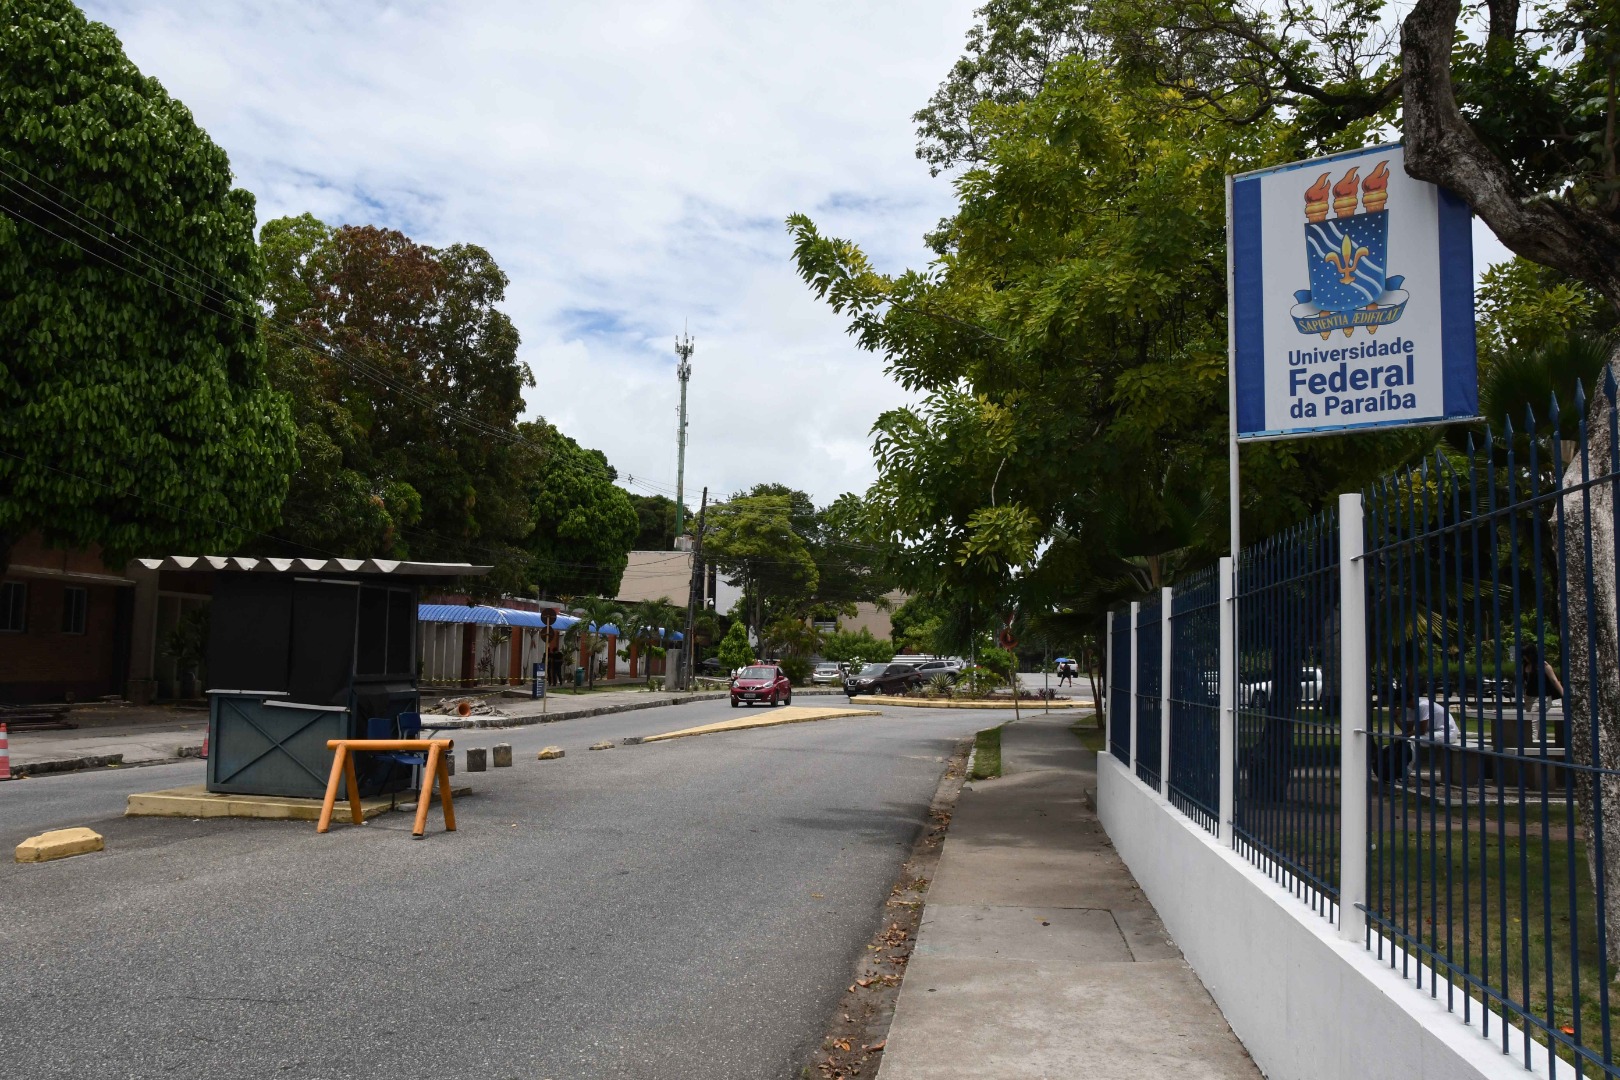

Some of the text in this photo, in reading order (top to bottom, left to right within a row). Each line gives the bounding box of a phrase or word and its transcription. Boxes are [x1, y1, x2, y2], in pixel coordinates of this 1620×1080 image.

[1298, 315, 1349, 332] SAPIENTIA
[1288, 337, 1414, 366] Universidade
[1289, 355, 1415, 397] Federal
[1290, 389, 1417, 419] da Paraíba
